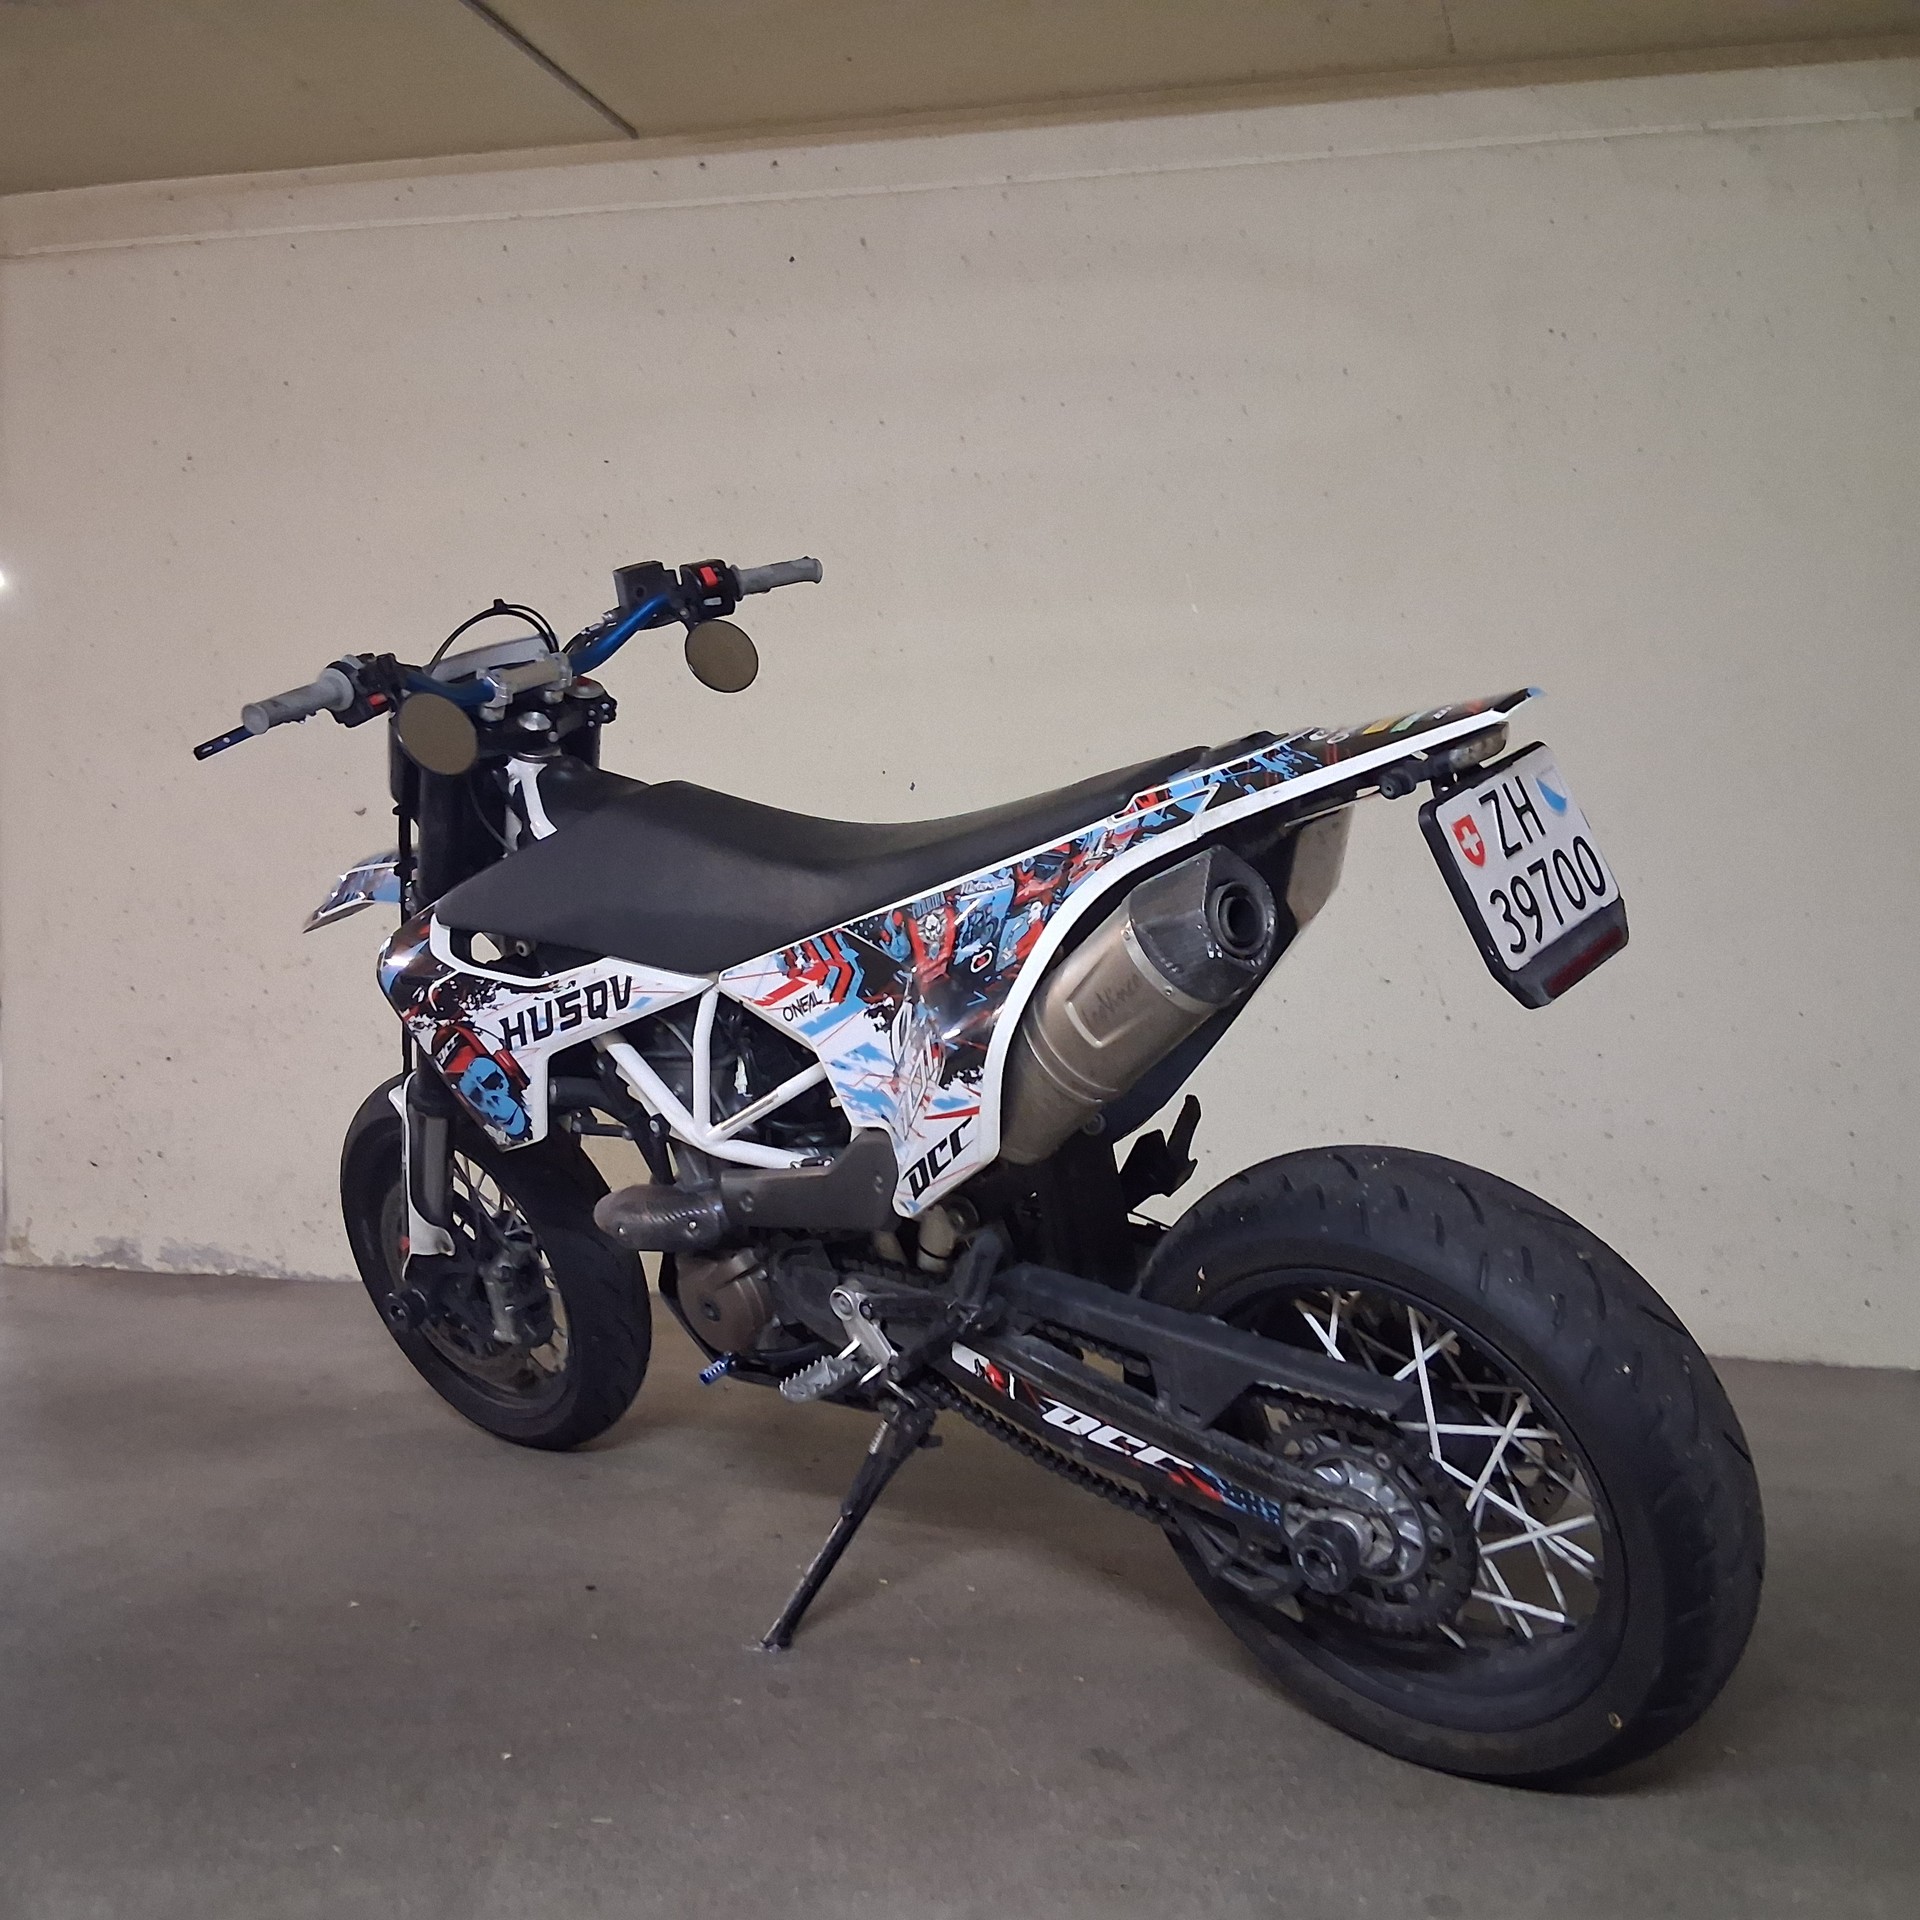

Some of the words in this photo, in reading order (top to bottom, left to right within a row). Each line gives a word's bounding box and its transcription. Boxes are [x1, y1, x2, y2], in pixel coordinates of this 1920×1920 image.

[1478, 775, 1546, 859] ZH
[1489, 836, 1606, 953] 39700
[499, 975, 632, 1050] HUSQV
